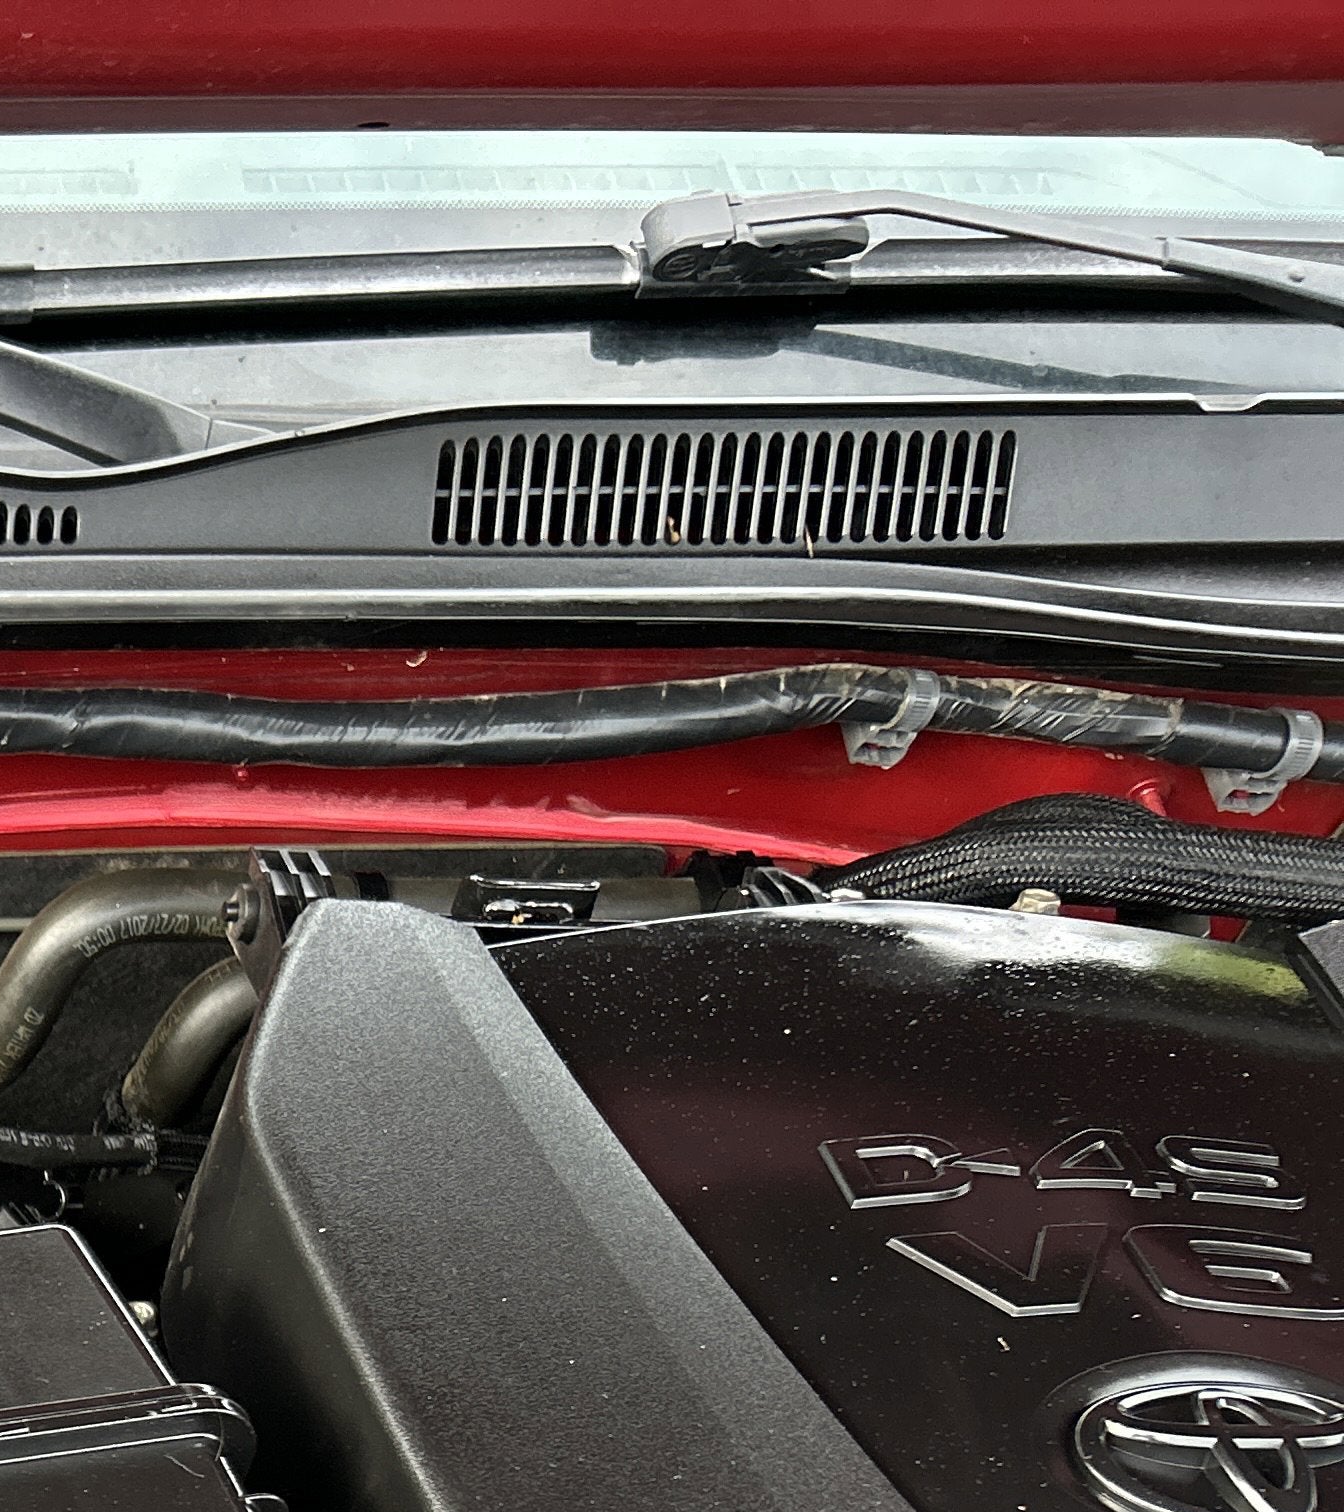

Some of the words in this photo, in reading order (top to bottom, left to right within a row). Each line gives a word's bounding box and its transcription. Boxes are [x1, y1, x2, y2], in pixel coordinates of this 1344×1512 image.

[119, 912, 190, 940] 02/27/2017
[818, 1128, 1307, 1210] D-4S
[886, 1223, 1344, 1321] V6
